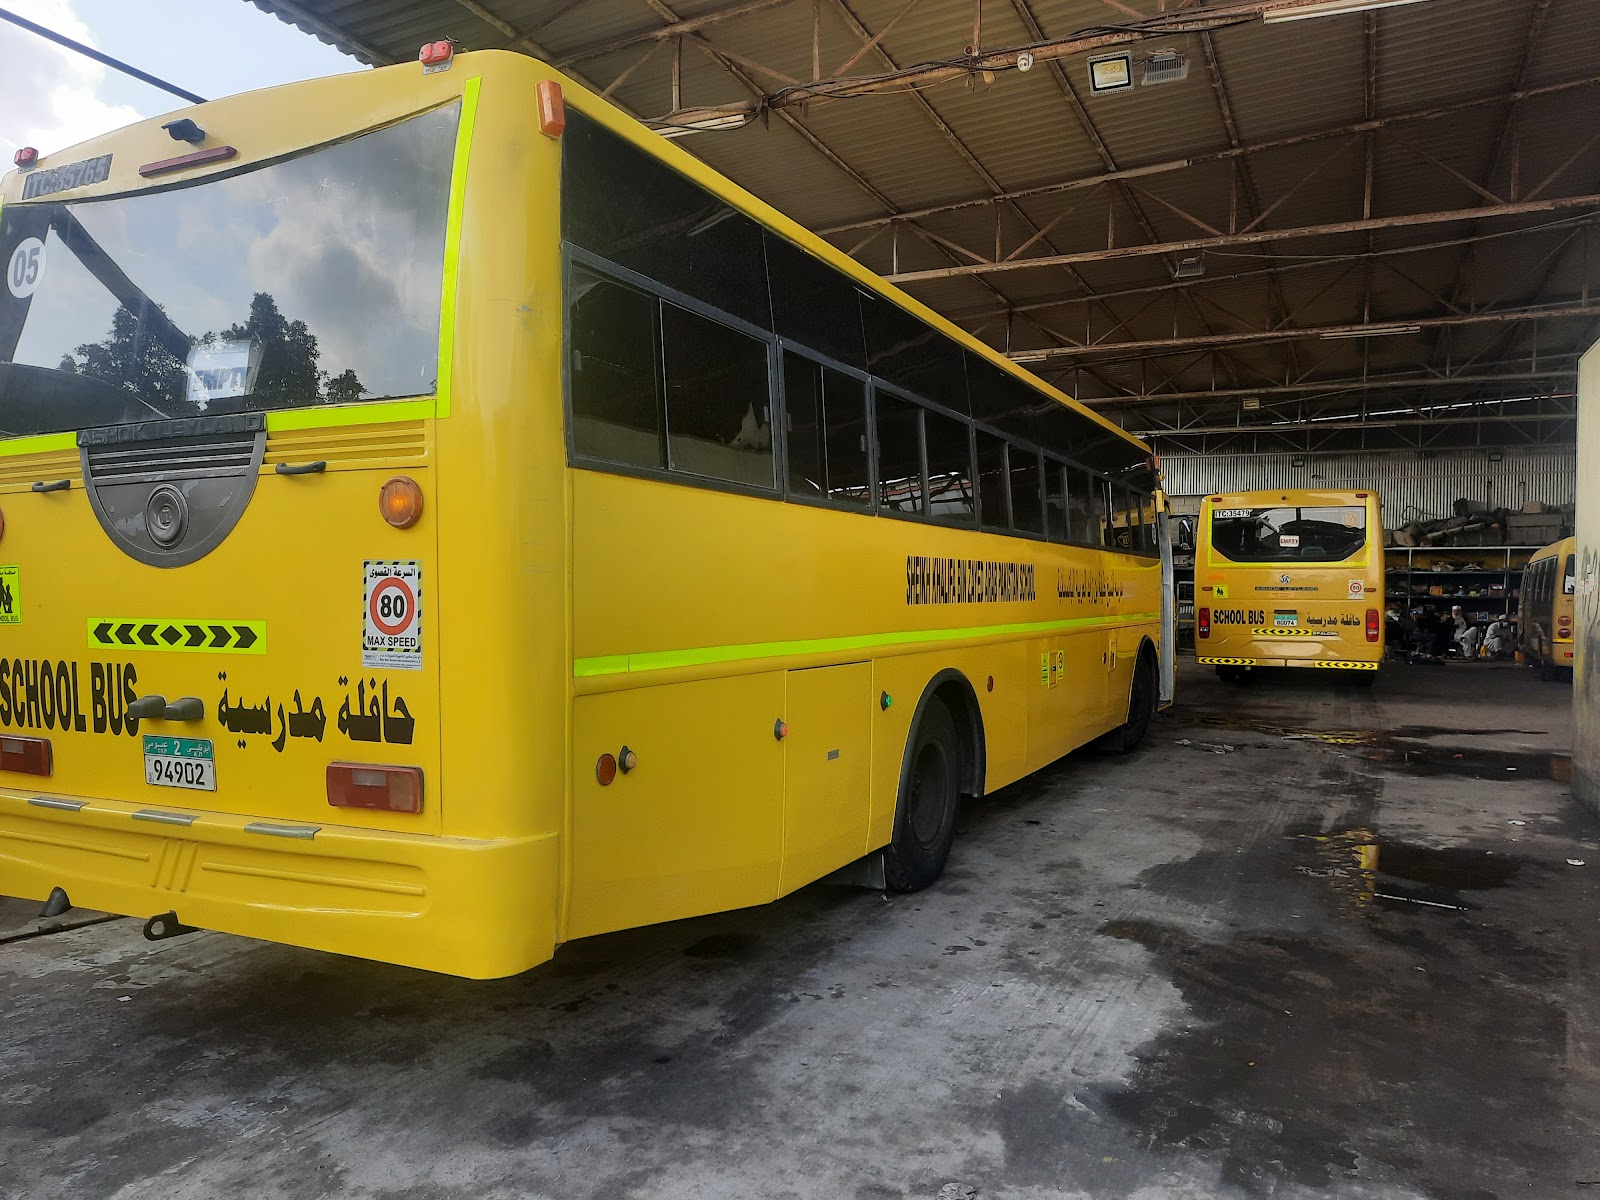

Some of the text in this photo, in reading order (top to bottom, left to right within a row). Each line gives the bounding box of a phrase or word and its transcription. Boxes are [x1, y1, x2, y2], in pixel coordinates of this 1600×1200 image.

[13, 247, 40, 287] 05
[78, 414, 264, 446] ASHOK LEYLAND
[394, 567, 416, 579] السرعة
[906, 555, 931, 606] SHEIKH
[381, 594, 405, 618] 80
[1213, 610, 1265, 625] SCHOOL BUS
[1340, 613, 1361, 626] حافلة
[367, 635, 417, 647] MAX SPEED
[0, 658, 140, 737] SCHOOL BUS
[217, 671, 415, 753] حافلة مدرسية
[173, 740, 182, 756] 2
[154, 760, 206, 786] 94902
